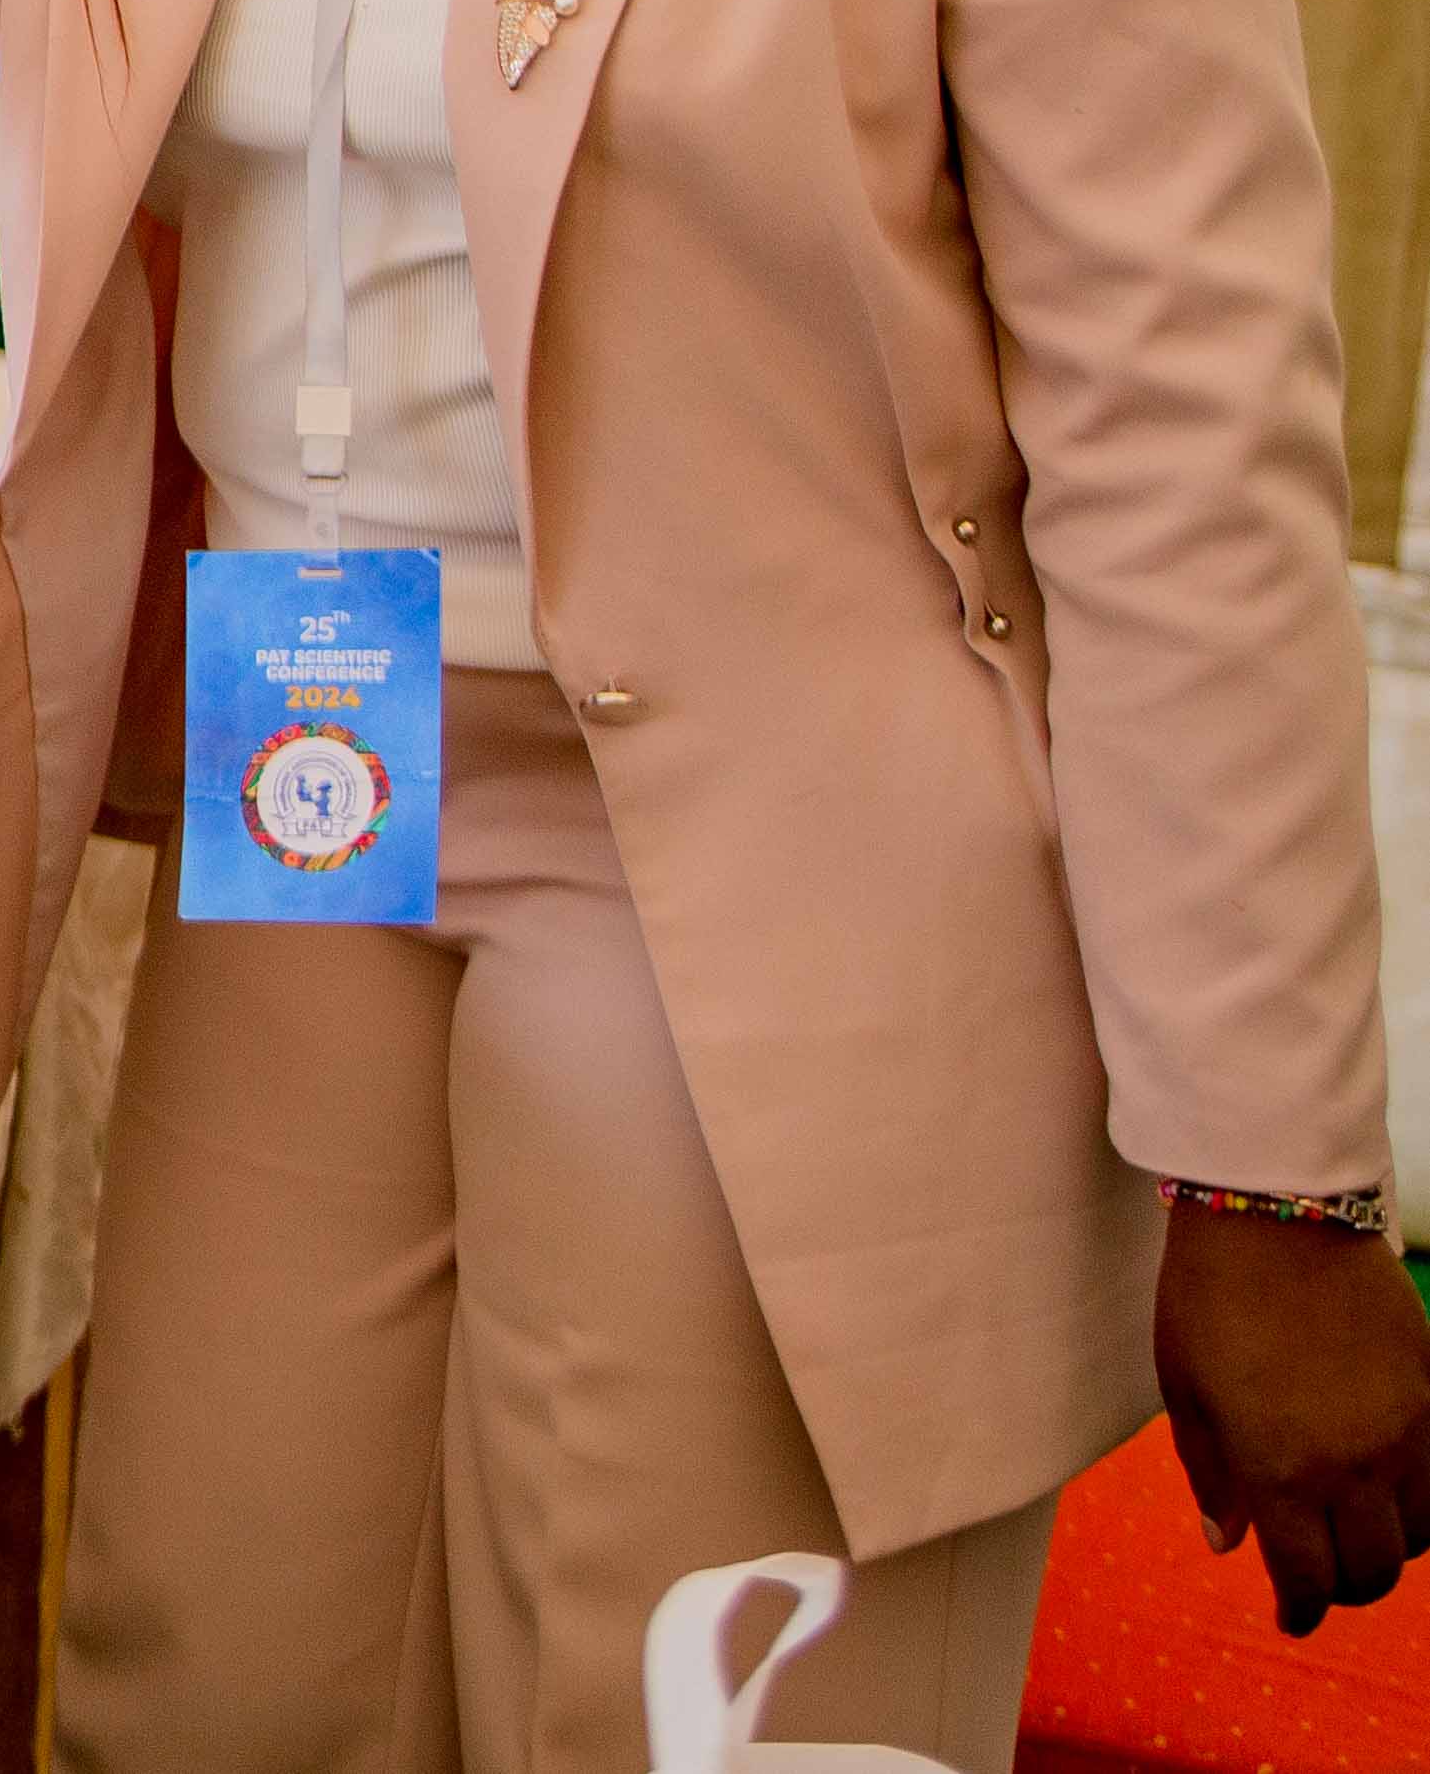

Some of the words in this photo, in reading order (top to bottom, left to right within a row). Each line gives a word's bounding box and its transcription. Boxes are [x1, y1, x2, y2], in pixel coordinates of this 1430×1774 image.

[255, 649, 290, 667] PAT
[293, 649, 393, 667] SCIENTIFIC
[266, 665, 387, 683] CONFERENCE
[285, 686, 362, 711] 2024
